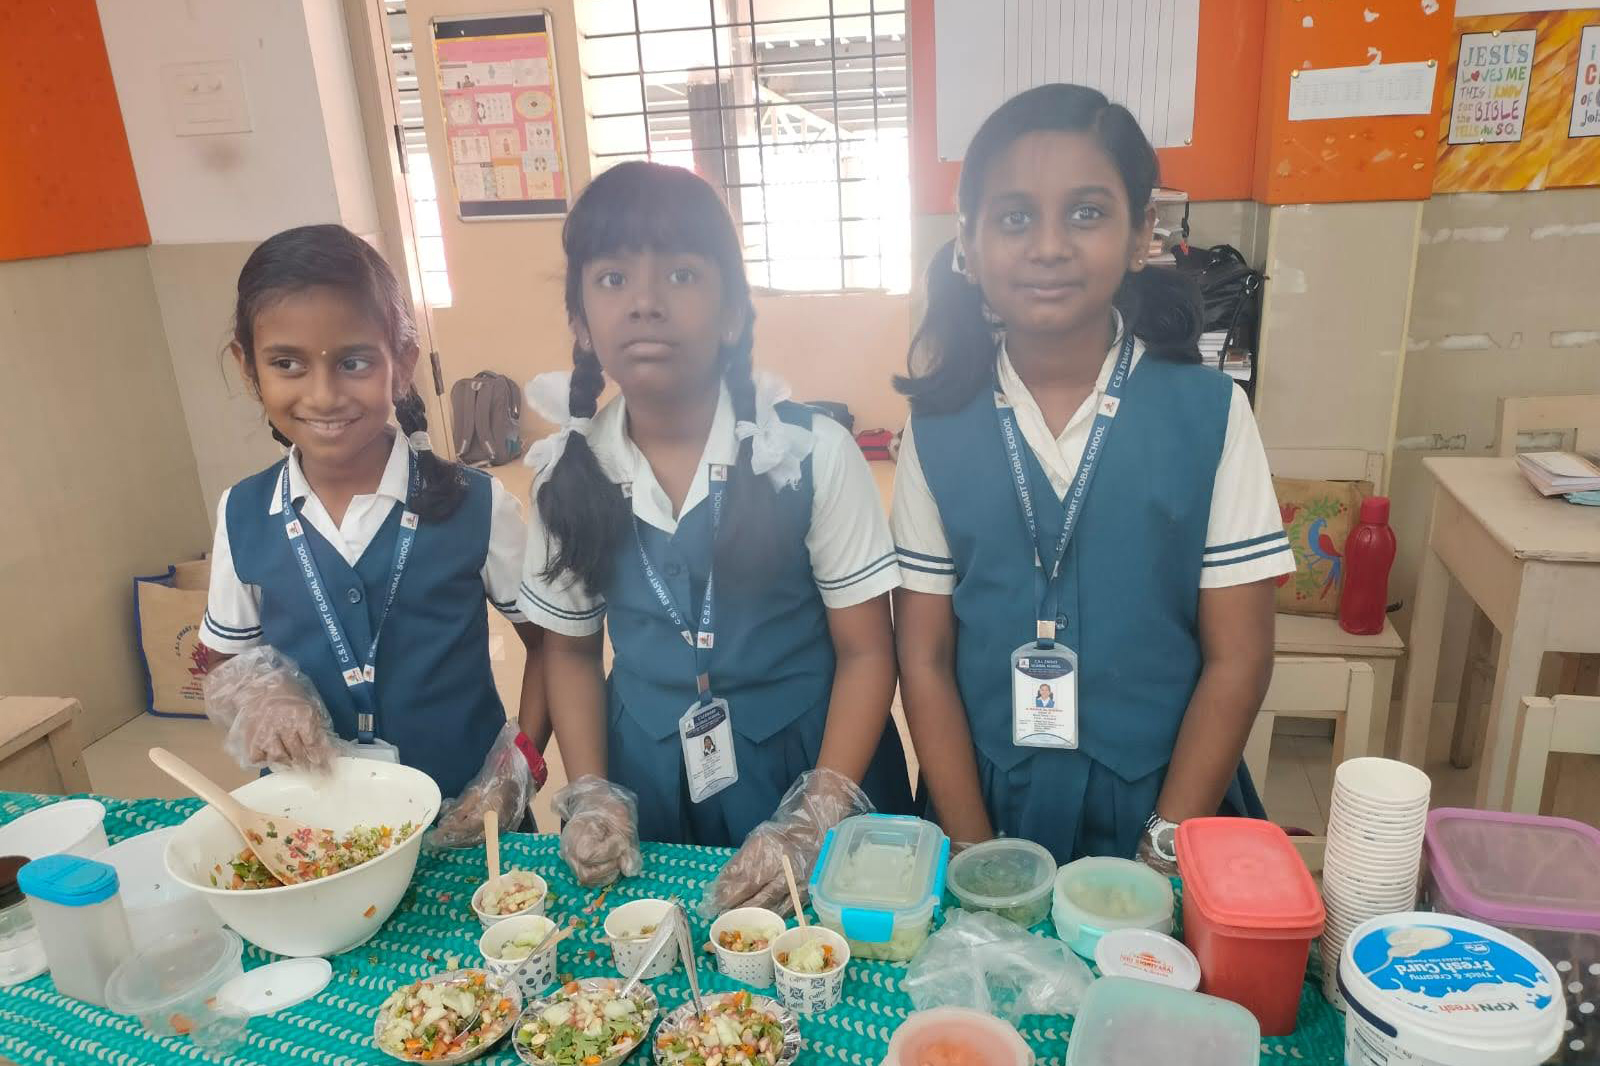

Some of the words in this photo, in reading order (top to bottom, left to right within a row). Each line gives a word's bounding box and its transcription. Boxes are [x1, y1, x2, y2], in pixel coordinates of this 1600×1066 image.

[1463, 43, 1530, 67] JESUS
[1505, 66, 1528, 81] ME
[1460, 85, 1486, 99] THIS
[1493, 84, 1524, 99] KNOW
[1474, 100, 1520, 122] BIBLE
[1455, 124, 1479, 138] TELLS
[1002, 417, 1016, 450] SCHOOL
[1011, 450, 1025, 485] GLOBAL
[1064, 497, 1079, 530] EWART
[1074, 462, 1092, 497] GLOBAL
[1086, 425, 1105, 461] SCHOOL
[1019, 485, 1033, 517] EWART
[297, 543, 315, 578] SCHOOL
[396, 535, 411, 570] SCHOOL
[310, 578, 328, 611] GLOBAL
[650, 577, 670, 606] EWART
[323, 613, 341, 642] EWART
[1394, 963, 1440, 976] Curd
[1409, 973, 1452, 981] Creamy
[1439, 960, 1495, 973] Fresh
[1463, 971, 1494, 979] Thick
